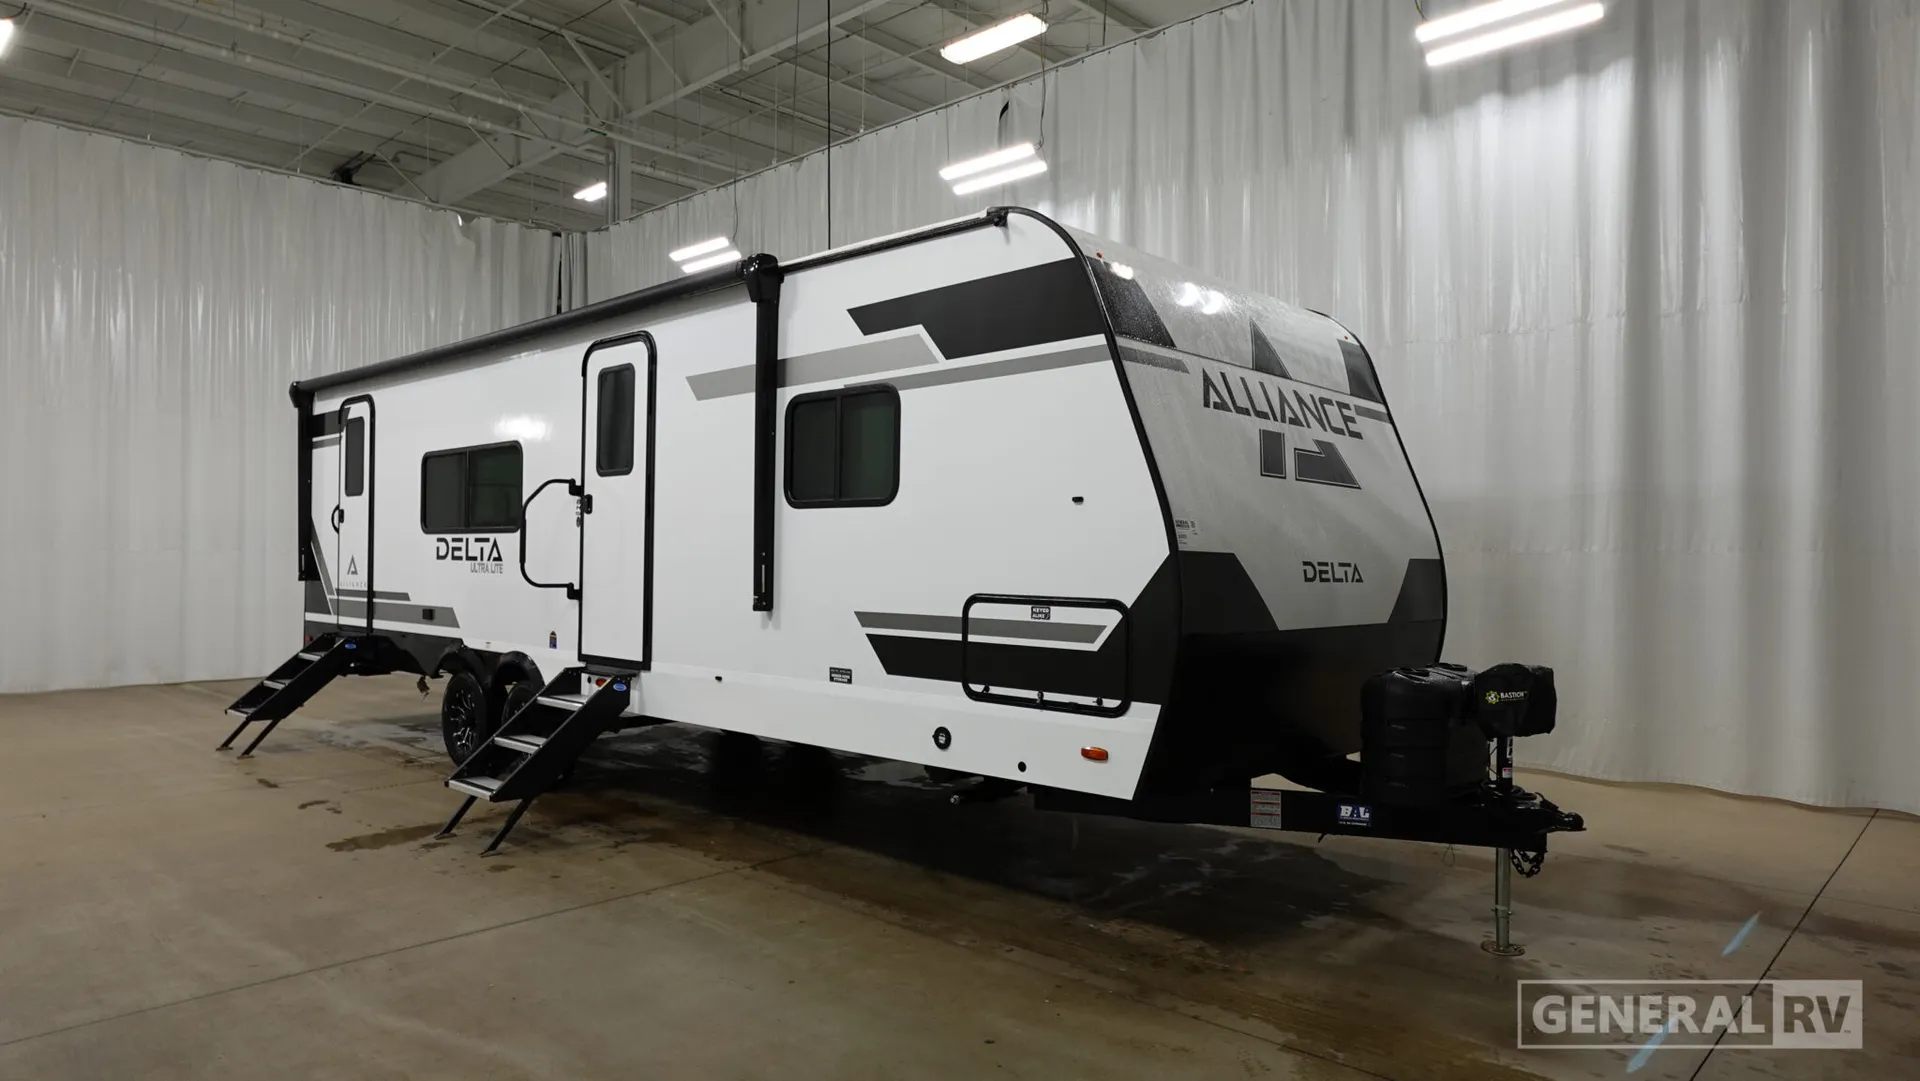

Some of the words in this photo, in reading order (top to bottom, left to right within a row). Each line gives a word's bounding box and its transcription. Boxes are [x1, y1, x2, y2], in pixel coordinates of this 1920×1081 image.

[1202, 367, 1363, 440] ALLIANCE
[436, 537, 503, 561] DELTA
[470, 562, 489, 574] ULTRA
[490, 562, 503, 575] LITE
[1302, 561, 1364, 583] DELTA
[1500, 691, 1524, 699] BASTION
